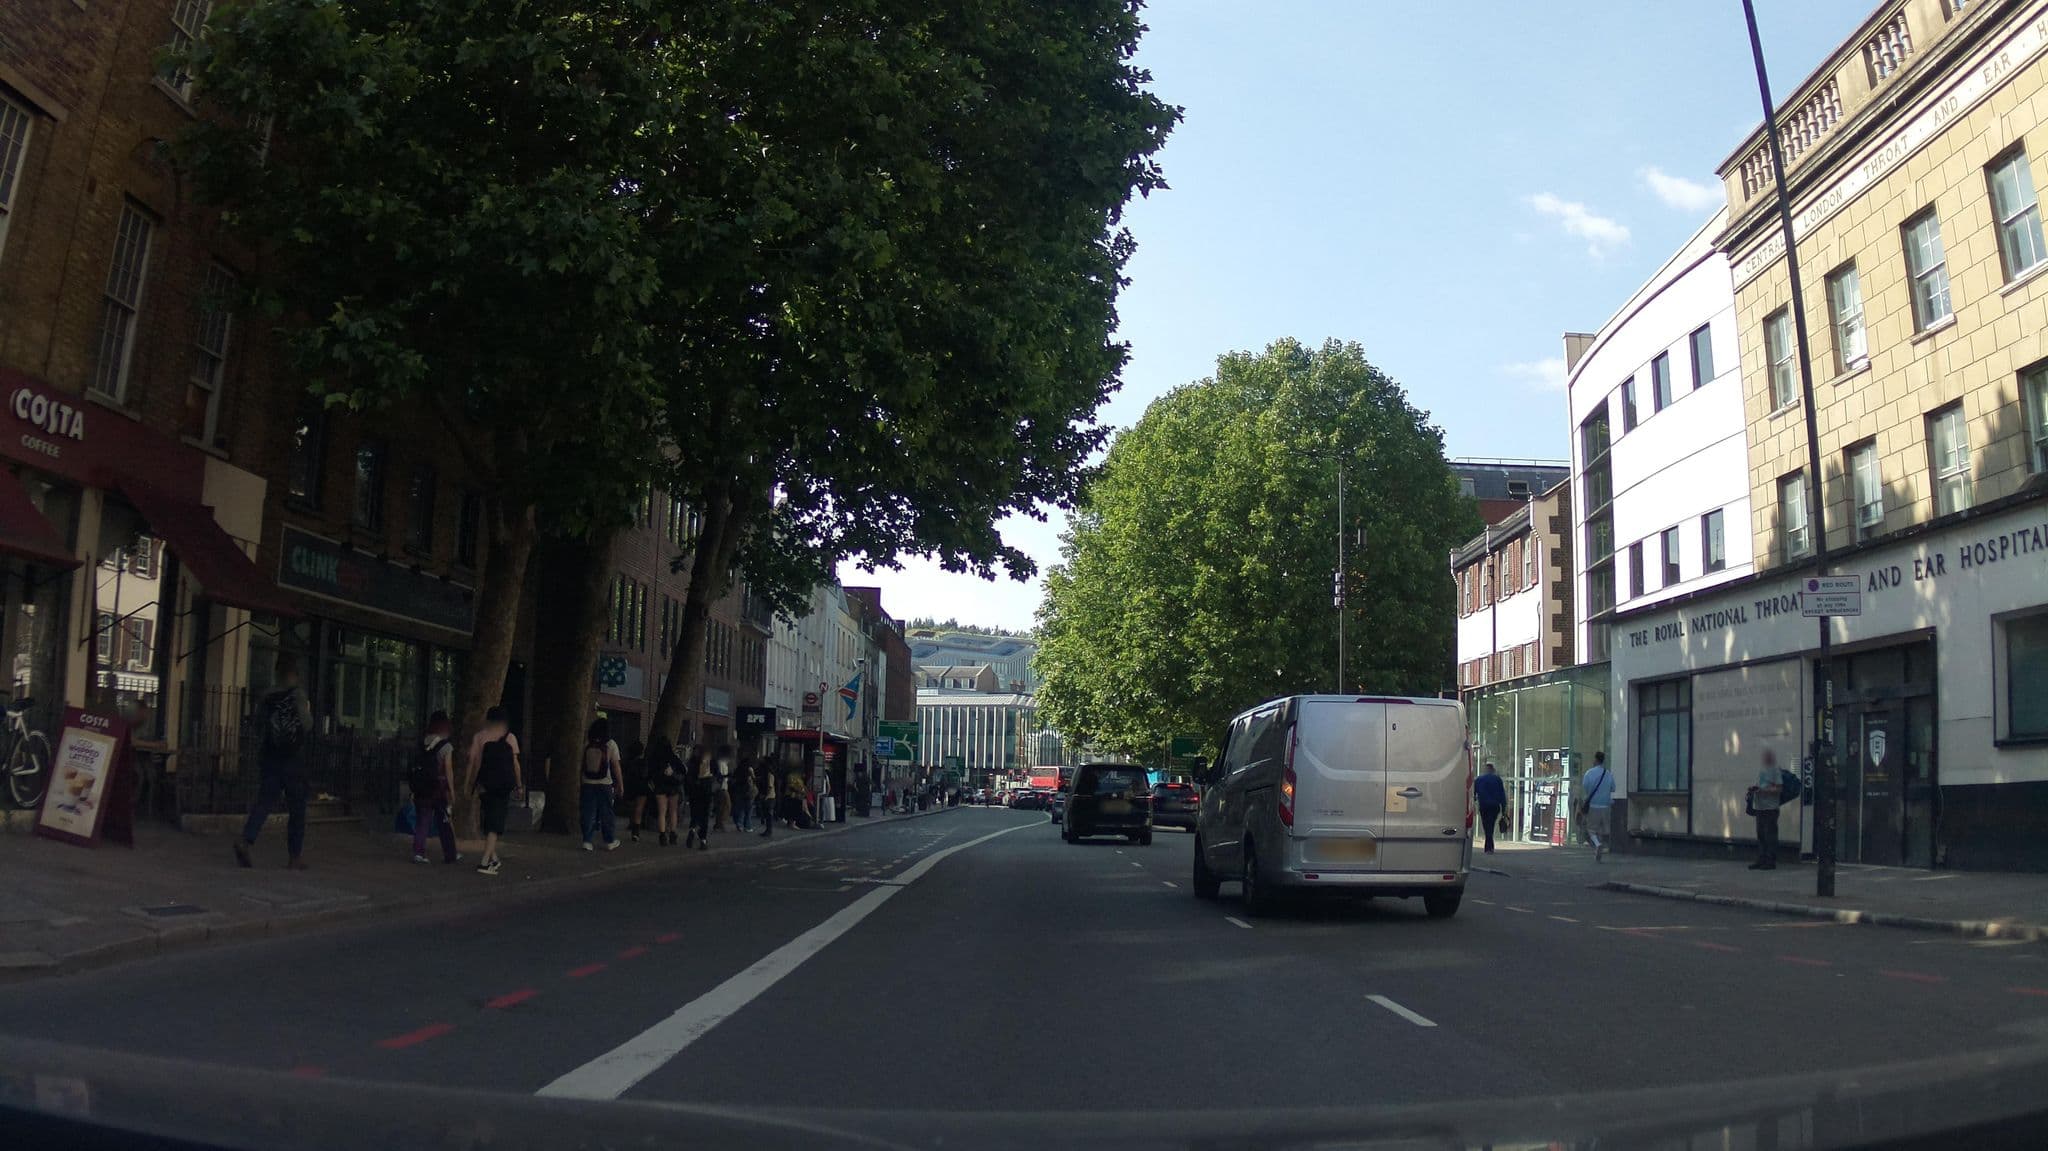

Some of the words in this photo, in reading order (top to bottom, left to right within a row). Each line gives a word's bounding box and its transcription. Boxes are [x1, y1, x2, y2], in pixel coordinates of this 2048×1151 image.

[1745, 235, 1787, 273] CENTRAL
[1803, 186, 1843, 229] LONDON
[1863, 134, 1909, 180] THROAT
[1933, 96, 1959, 126] AND
[1983, 52, 2012, 85] EAR
[10, 388, 84, 441] COSTA
[21, 434, 62, 458] COFFEE
[292, 545, 338, 584] CLINK
[1630, 630, 1648, 648] THE
[1655, 621, 1685, 641] ROYAL
[1692, 607, 1747, 633] NATIONAL
[1755, 591, 1803, 619] THROAT
[1868, 566, 1901, 592] AND
[1914, 553, 1947, 581] EAR
[80, 714, 109, 728] COSTA
